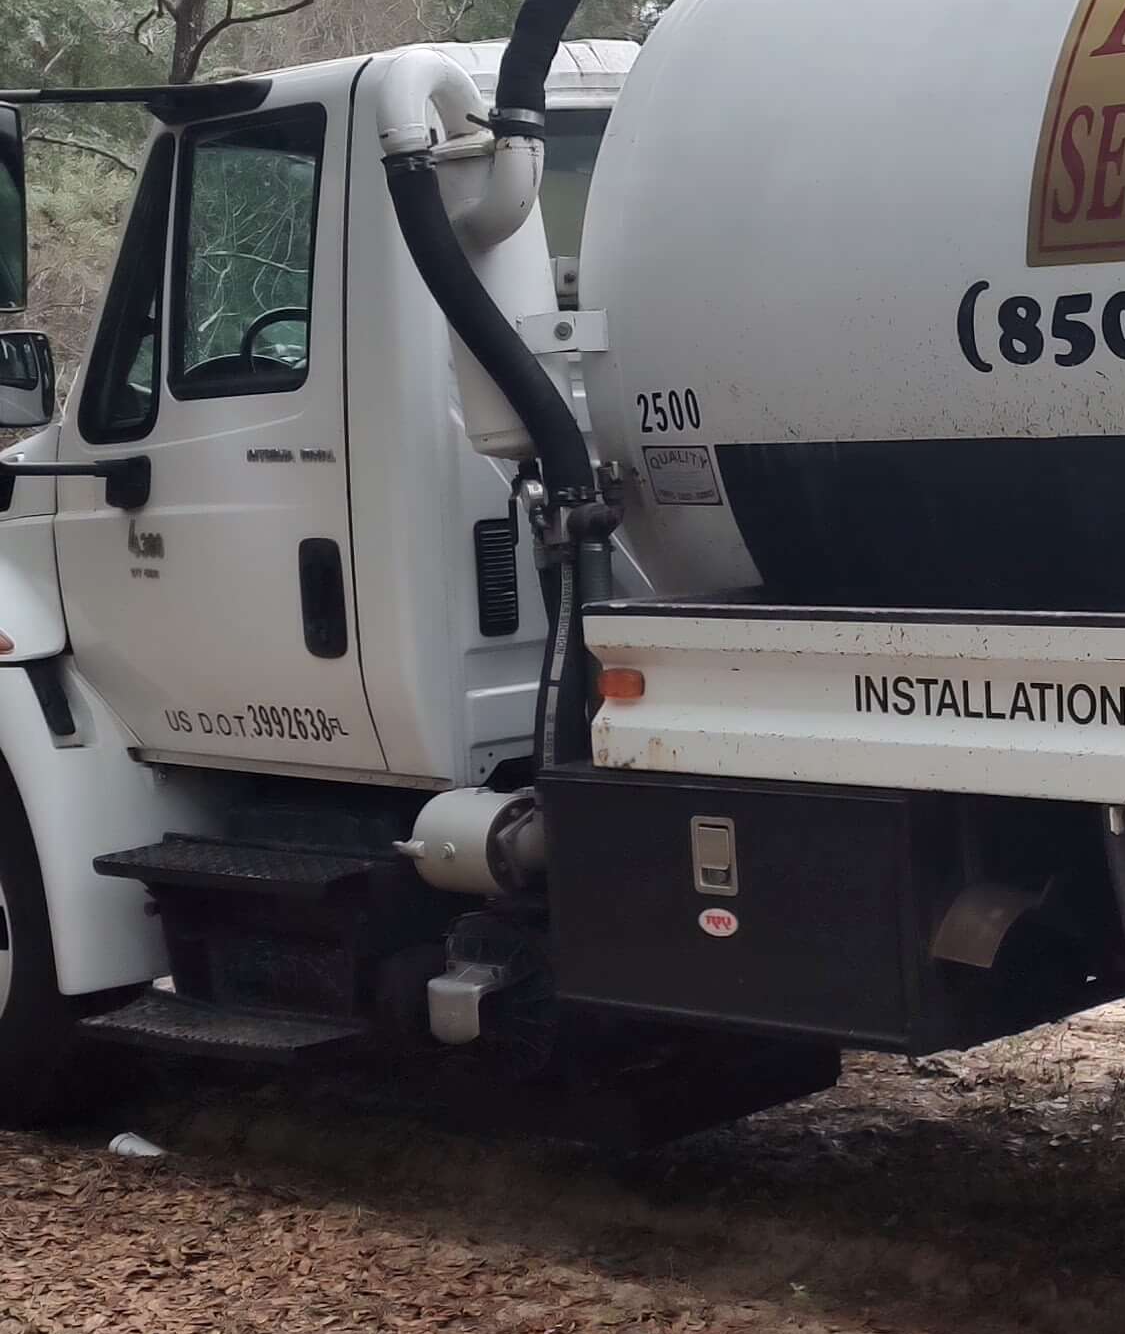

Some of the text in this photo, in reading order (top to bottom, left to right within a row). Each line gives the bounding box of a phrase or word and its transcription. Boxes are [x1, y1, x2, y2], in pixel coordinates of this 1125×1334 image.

[636, 388, 701, 434] 2500
[649, 450, 708, 470] QUALITY
[165, 709, 193, 733] US
